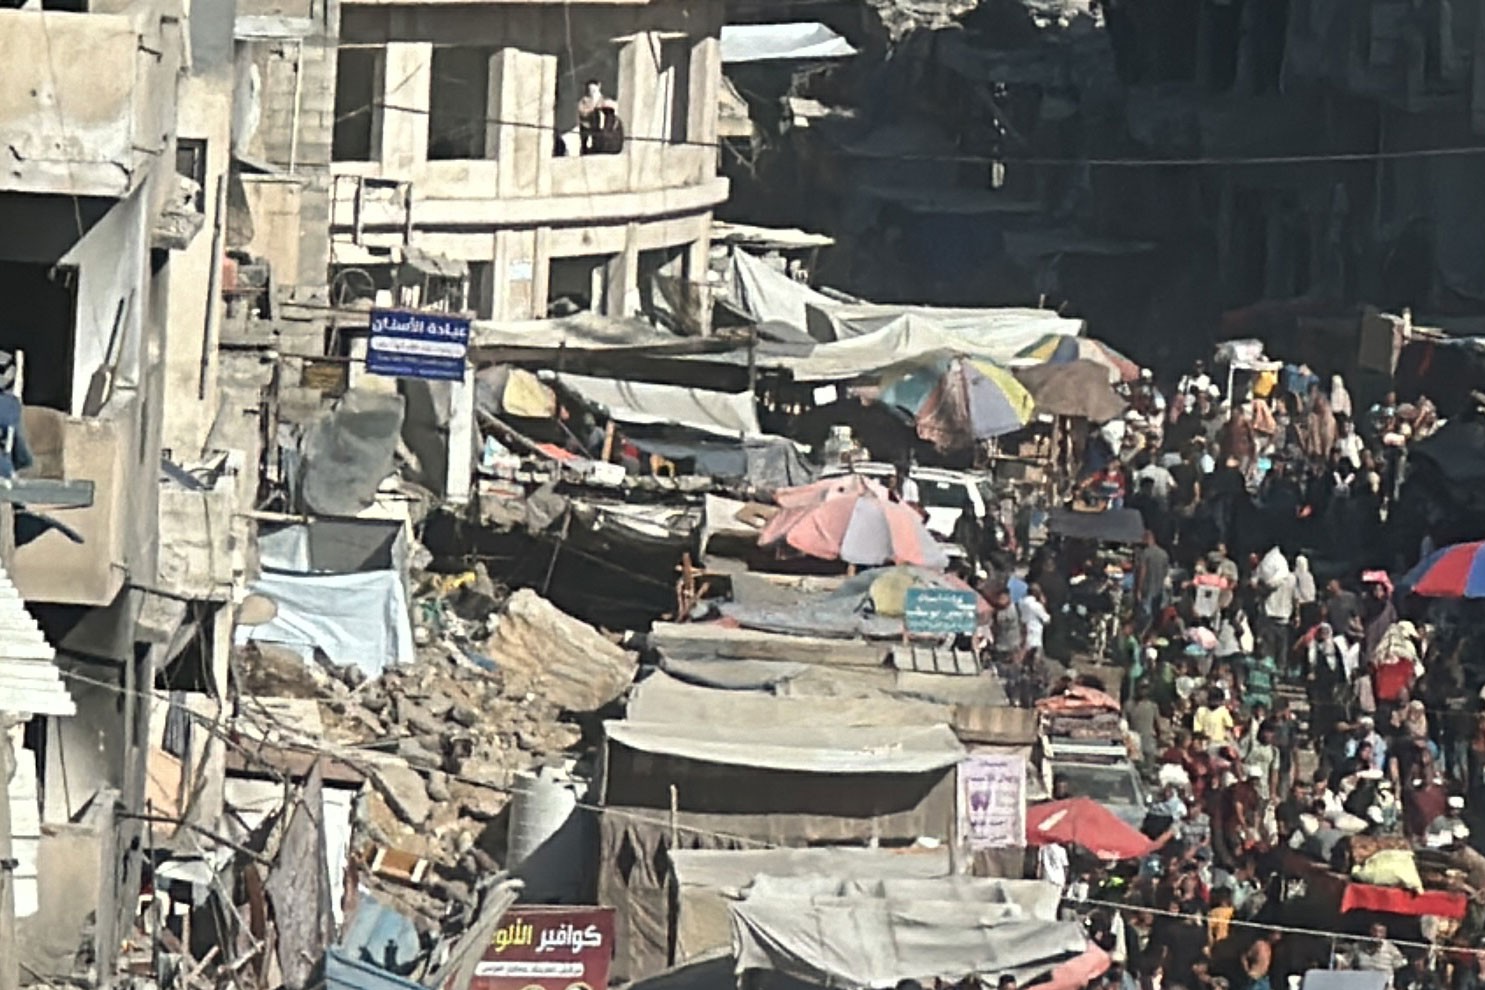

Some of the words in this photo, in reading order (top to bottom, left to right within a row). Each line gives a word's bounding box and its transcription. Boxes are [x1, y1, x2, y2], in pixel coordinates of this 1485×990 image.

[372, 316, 425, 333] الأسنان
[427, 321, 467, 340] عيادة
[535, 923, 602, 954] كوافير
